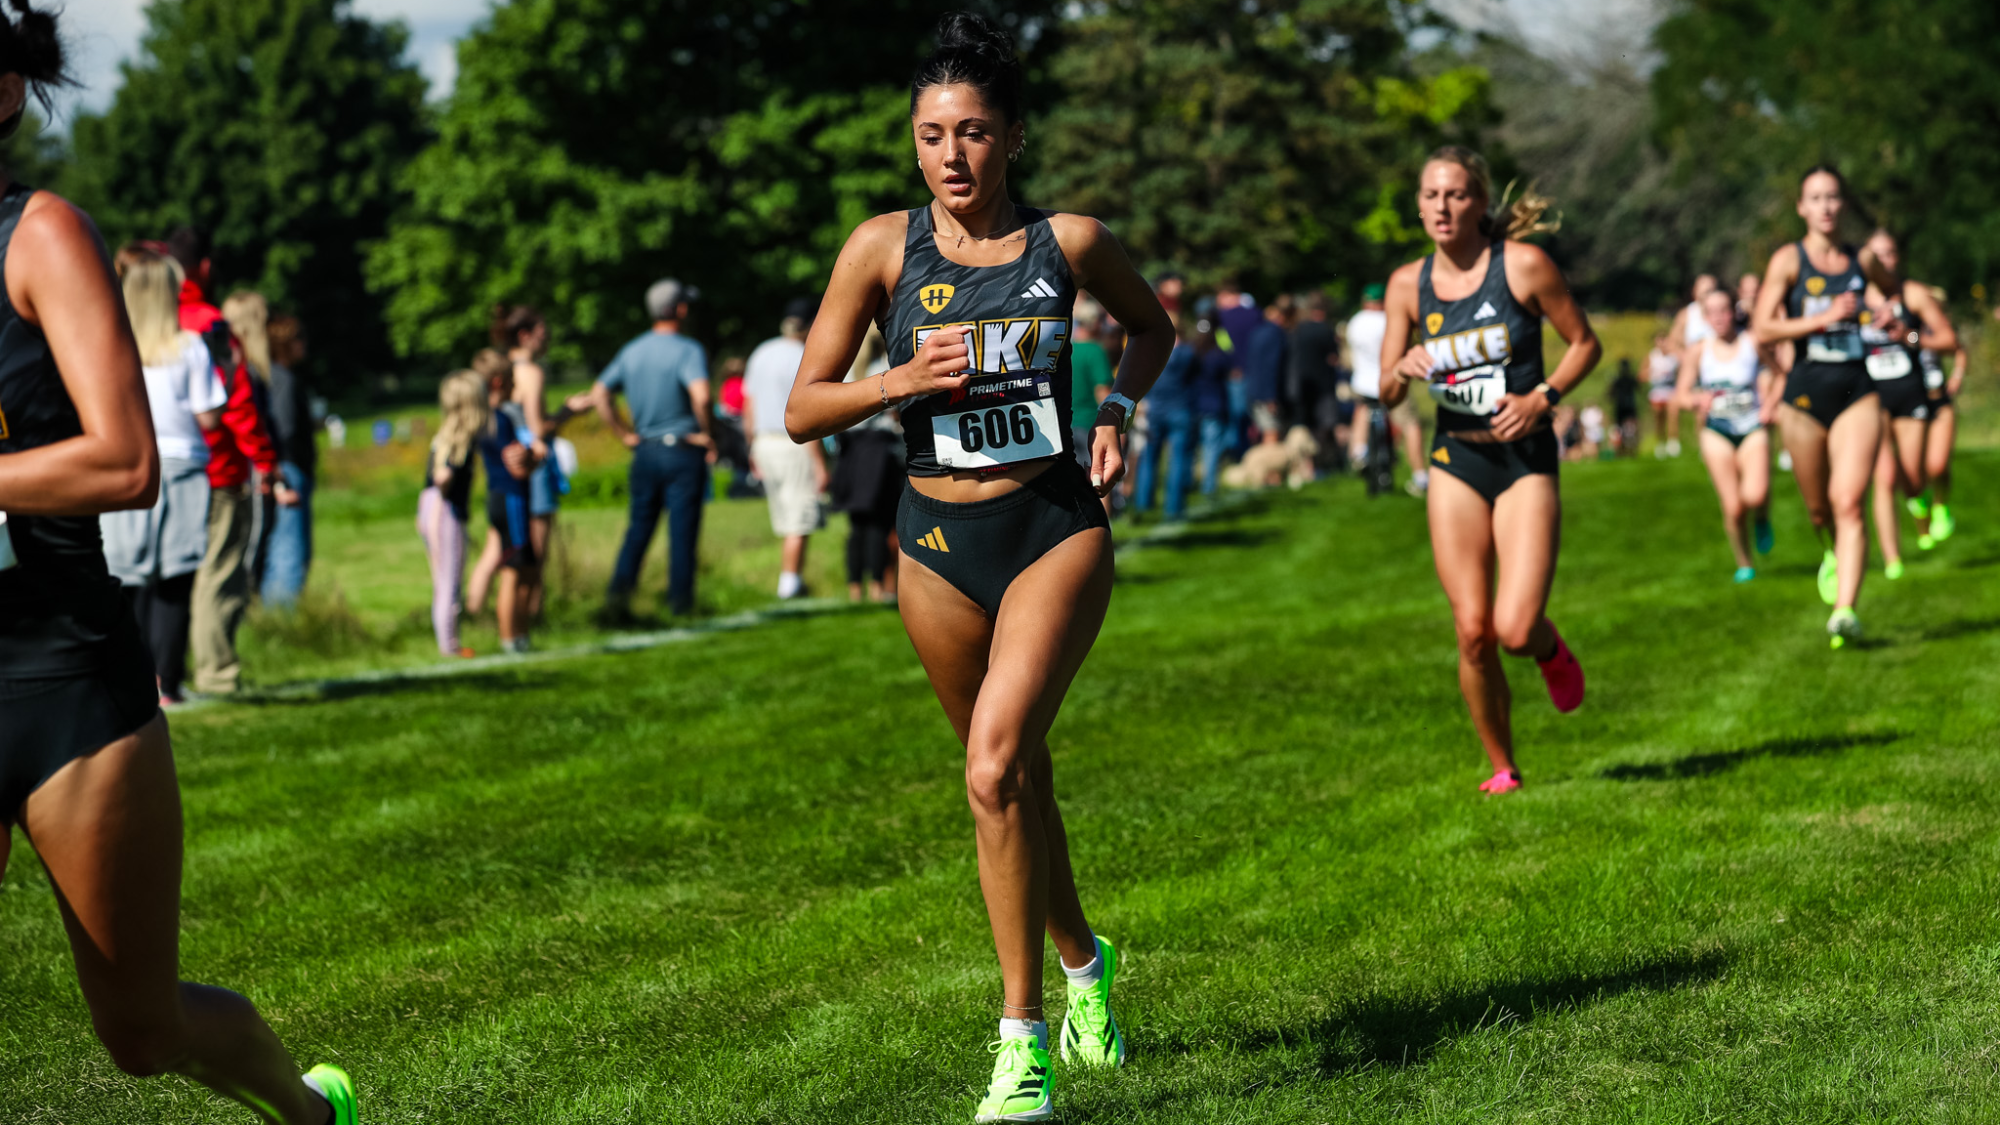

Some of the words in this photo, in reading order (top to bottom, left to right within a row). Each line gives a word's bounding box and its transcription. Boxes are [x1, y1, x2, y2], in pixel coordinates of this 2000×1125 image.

[1424, 323, 1512, 372] MKE
[969, 378, 1033, 396] PRIMETIME
[958, 404, 1035, 453] 606
